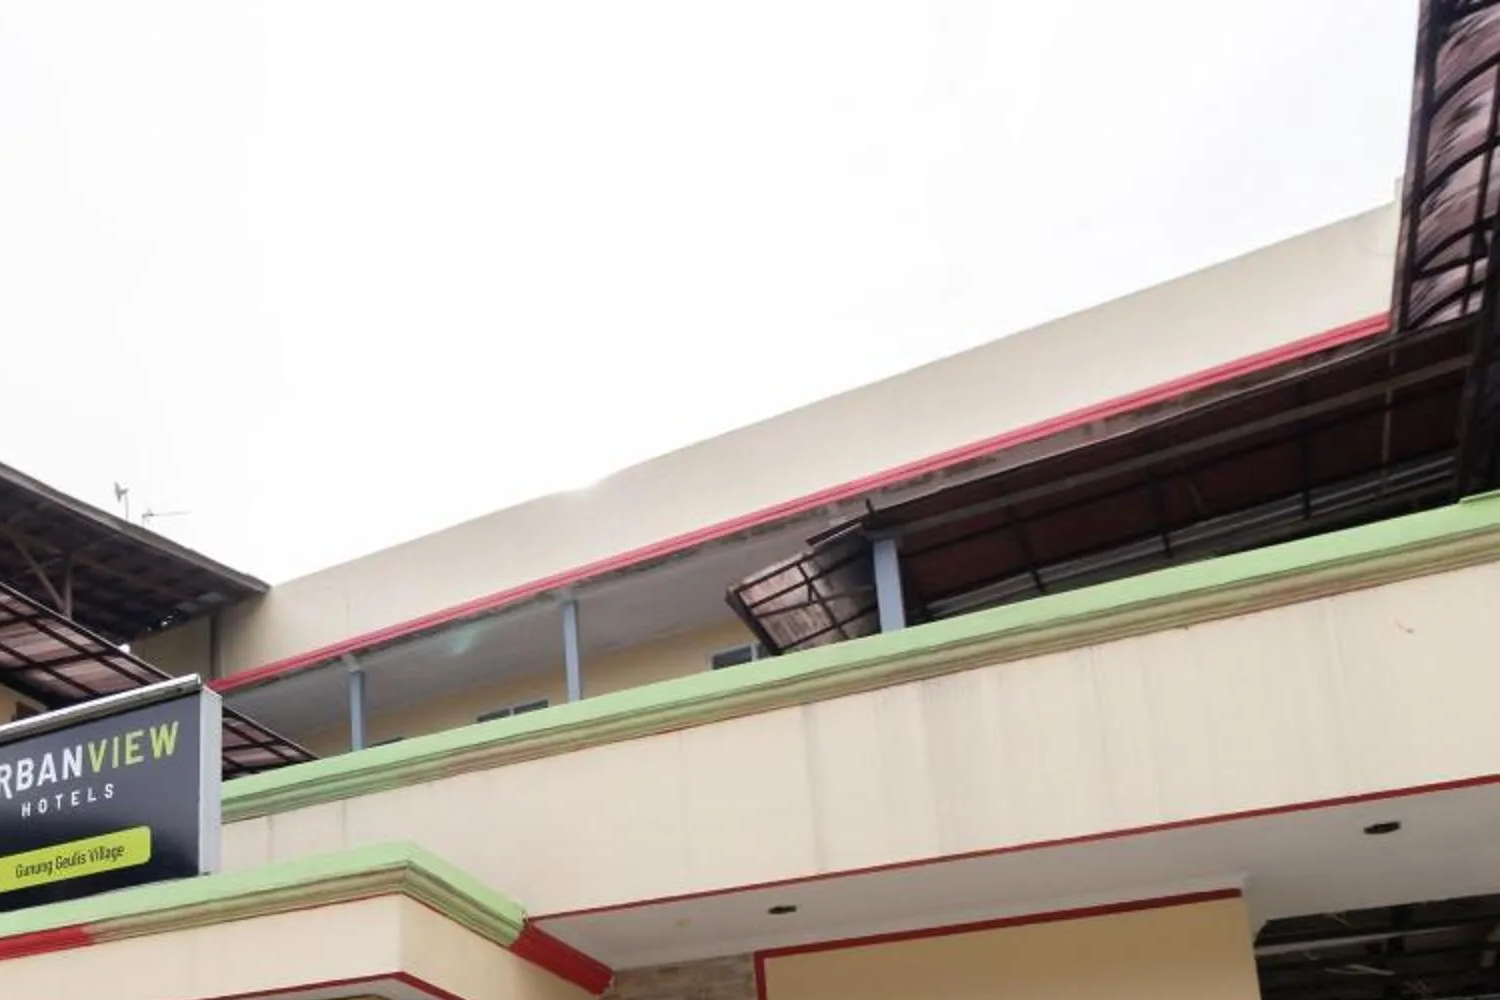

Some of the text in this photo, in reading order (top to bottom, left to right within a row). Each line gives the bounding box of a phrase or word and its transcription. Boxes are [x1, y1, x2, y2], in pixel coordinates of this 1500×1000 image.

[20, 783, 115, 818] HOTELS
[14, 844, 126, 879] Gunung Geulis Village
